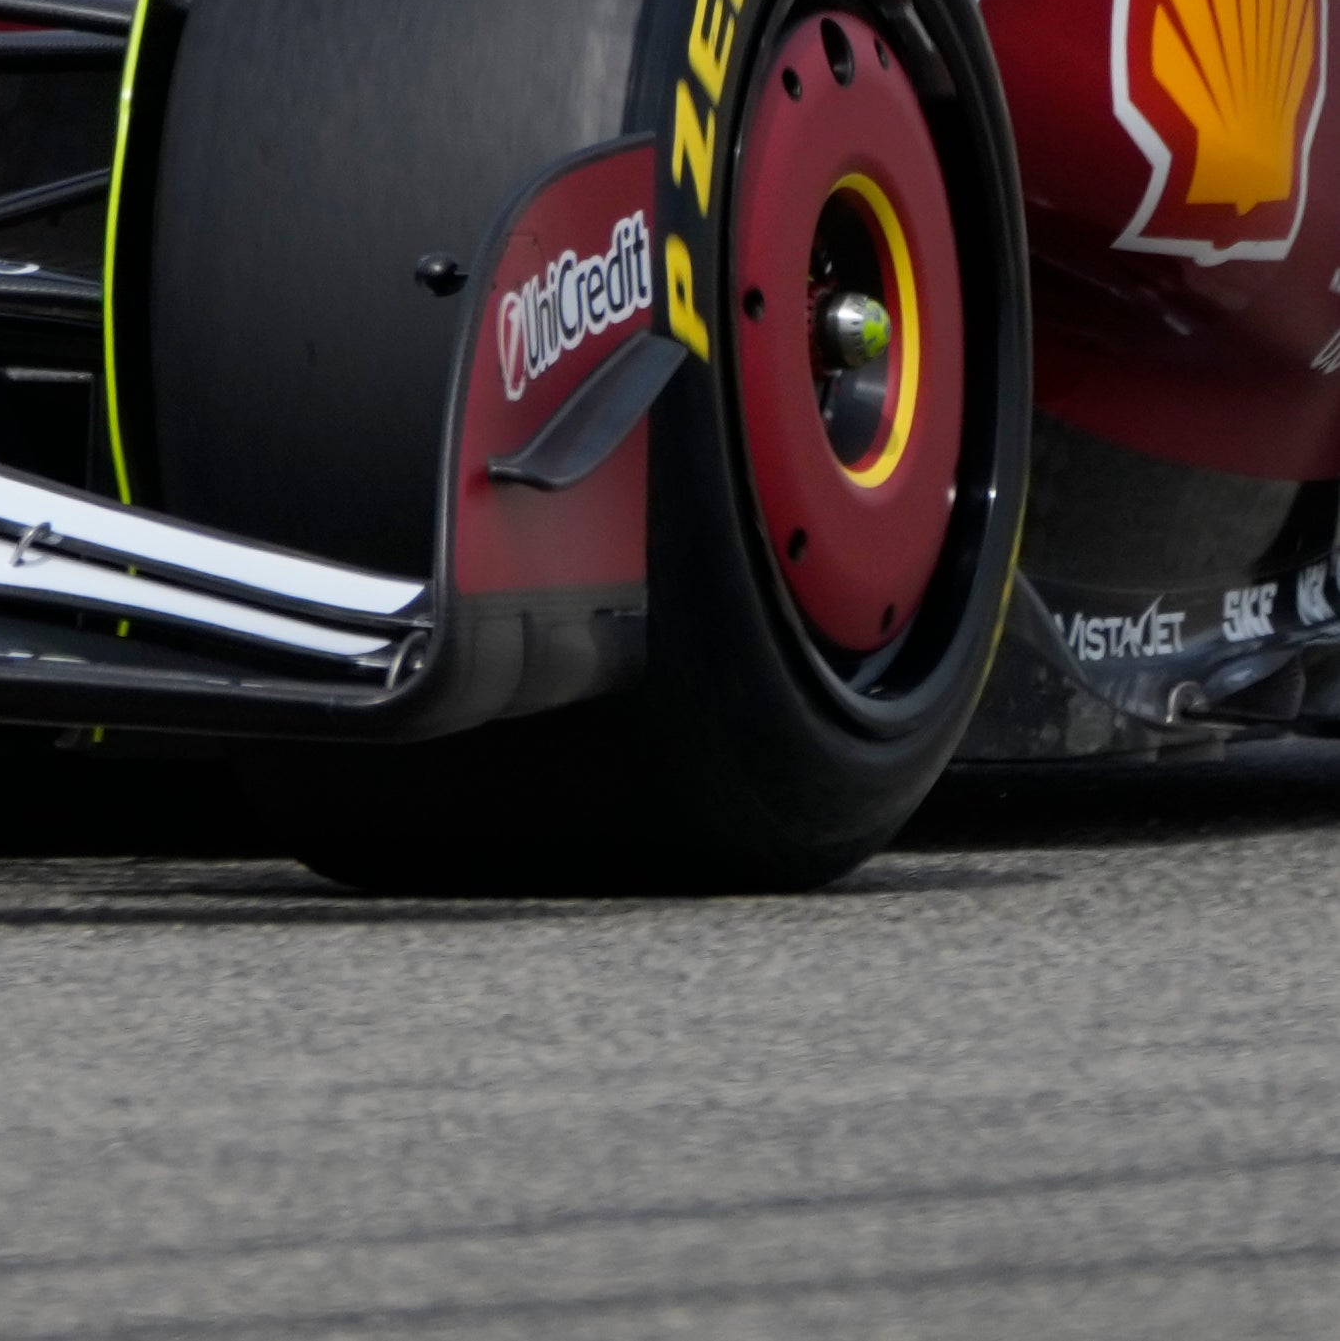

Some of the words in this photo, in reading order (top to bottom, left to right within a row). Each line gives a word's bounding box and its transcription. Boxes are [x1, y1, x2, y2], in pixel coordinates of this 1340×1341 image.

[522, 211, 652, 380] UniCredit
[664, 233, 710, 363] P
[1222, 582, 1279, 643] SKF
